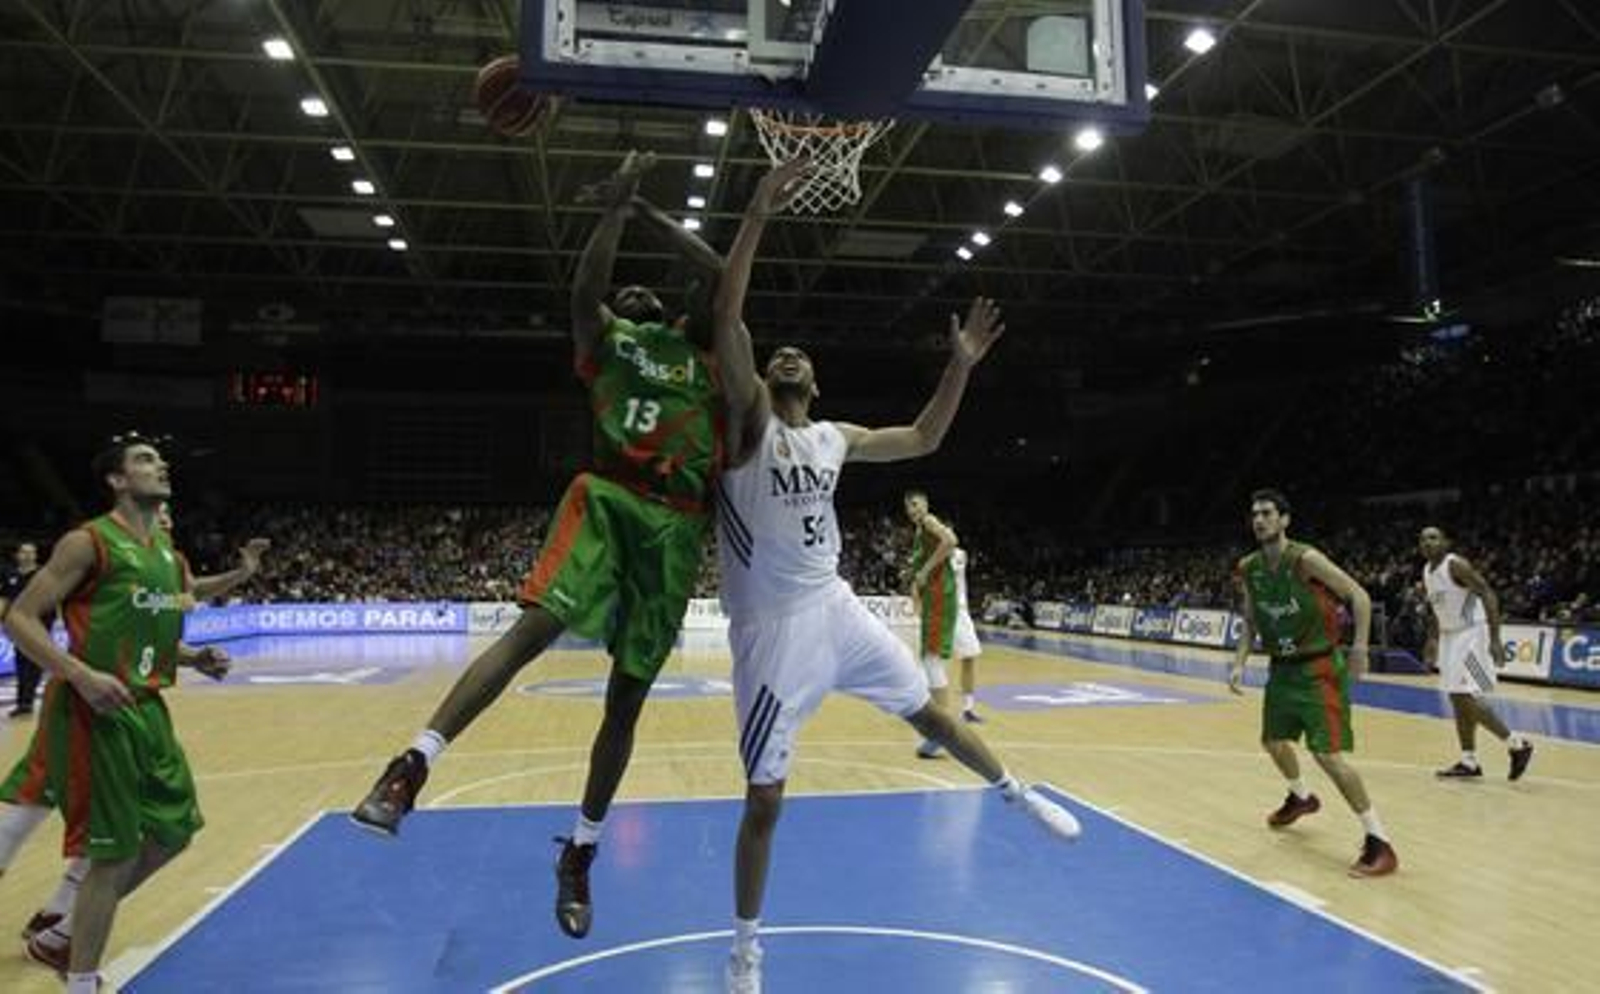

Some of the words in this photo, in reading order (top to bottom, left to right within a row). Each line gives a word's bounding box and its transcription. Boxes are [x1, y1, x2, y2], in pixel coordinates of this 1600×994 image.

[623, 398, 661, 434] 13
[364, 606, 457, 628] PARAR
[138, 646, 154, 676] 8
[1504, 630, 1546, 664] sol
